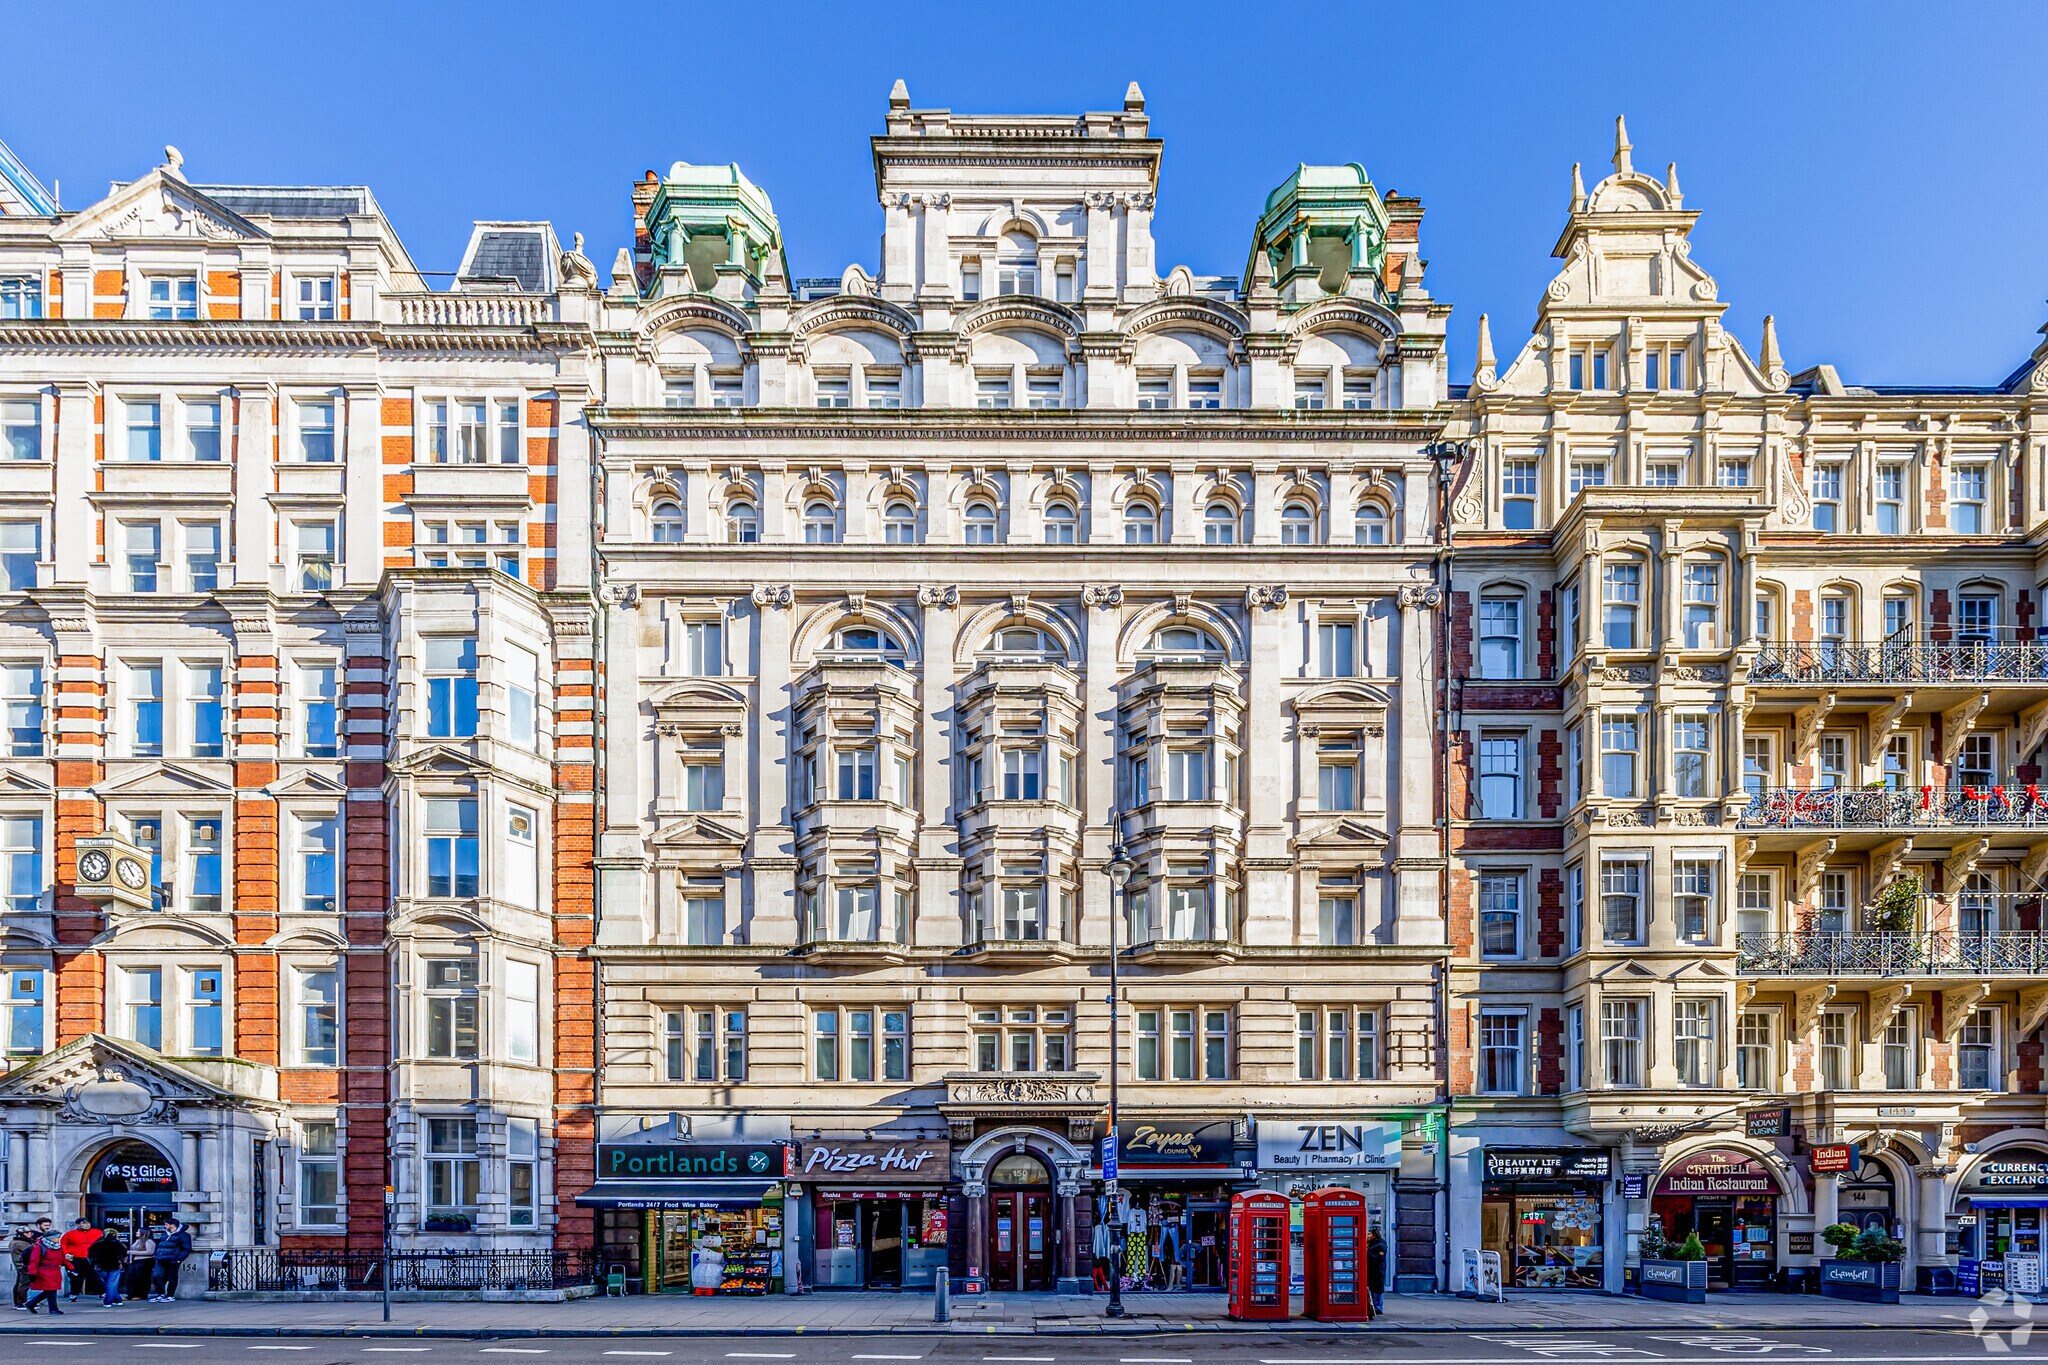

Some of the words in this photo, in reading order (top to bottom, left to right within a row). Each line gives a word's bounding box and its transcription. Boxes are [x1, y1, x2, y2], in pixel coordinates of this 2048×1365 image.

[1751, 1119, 1778, 1127] INDIAN
[1748, 1127, 1780, 1135] CUISINE
[1298, 1124, 1362, 1151] ZEN
[1817, 1149, 1846, 1158] Indian
[612, 1150, 737, 1173] Portlands
[804, 1147, 876, 1174] Pizza
[880, 1148, 934, 1171] Hut
[1274, 1155, 1300, 1166] Beauty
[1312, 1155, 1353, 1166] Pharmacy
[1364, 1154, 1385, 1163] Clinic
[122, 1165, 138, 1177] St
[140, 1165, 172, 1177] Giles
[1670, 1177, 1704, 1190] Indian
[1707, 1177, 1768, 1190] Restaurant
[1991, 1176, 2048, 1184] EXCHANG
[1853, 1193, 1866, 1201] 144
[1468, 1334, 1665, 1356] LANE
[1646, 1336, 1832, 1353] BUS
